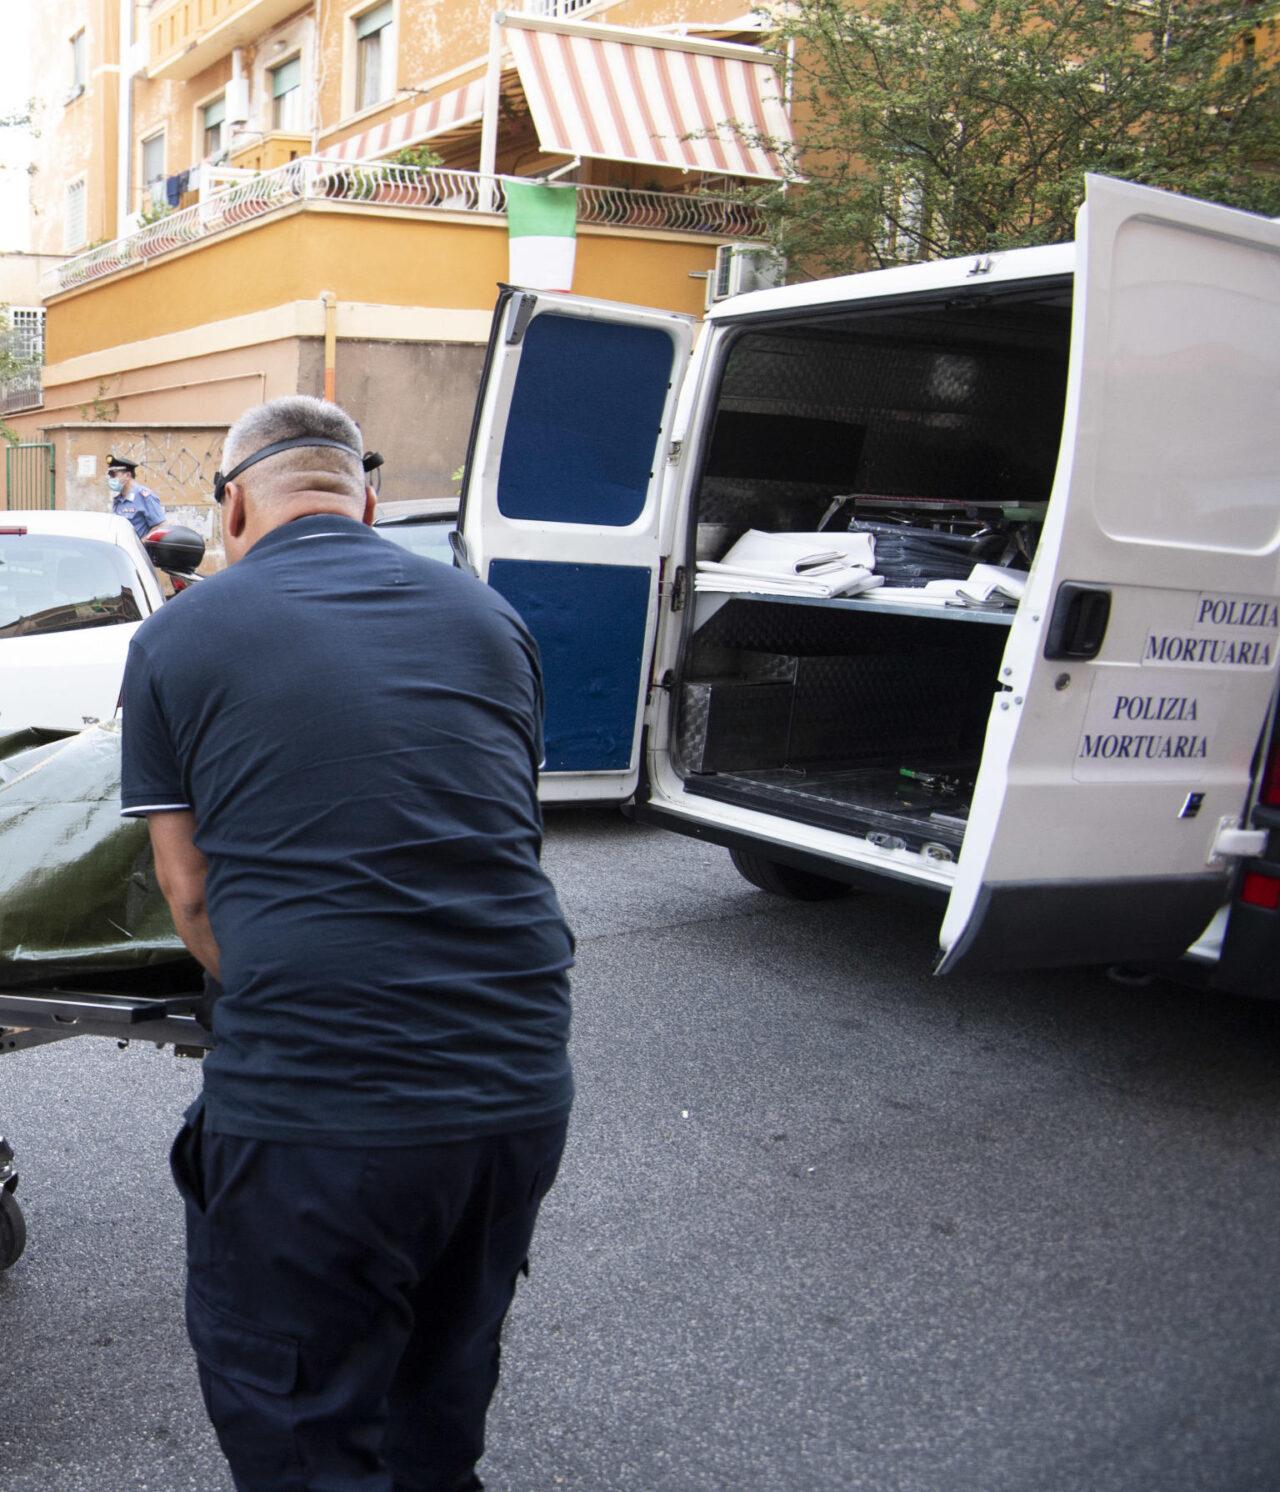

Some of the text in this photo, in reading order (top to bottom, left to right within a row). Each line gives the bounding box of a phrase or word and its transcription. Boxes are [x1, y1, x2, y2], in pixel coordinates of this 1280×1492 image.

[1197, 599, 1280, 628] POLIZIA
[1145, 635, 1270, 666] MORTUARIA
[1112, 695, 1198, 721] POLIZIA
[1078, 733, 1208, 759] MORTUARIA
